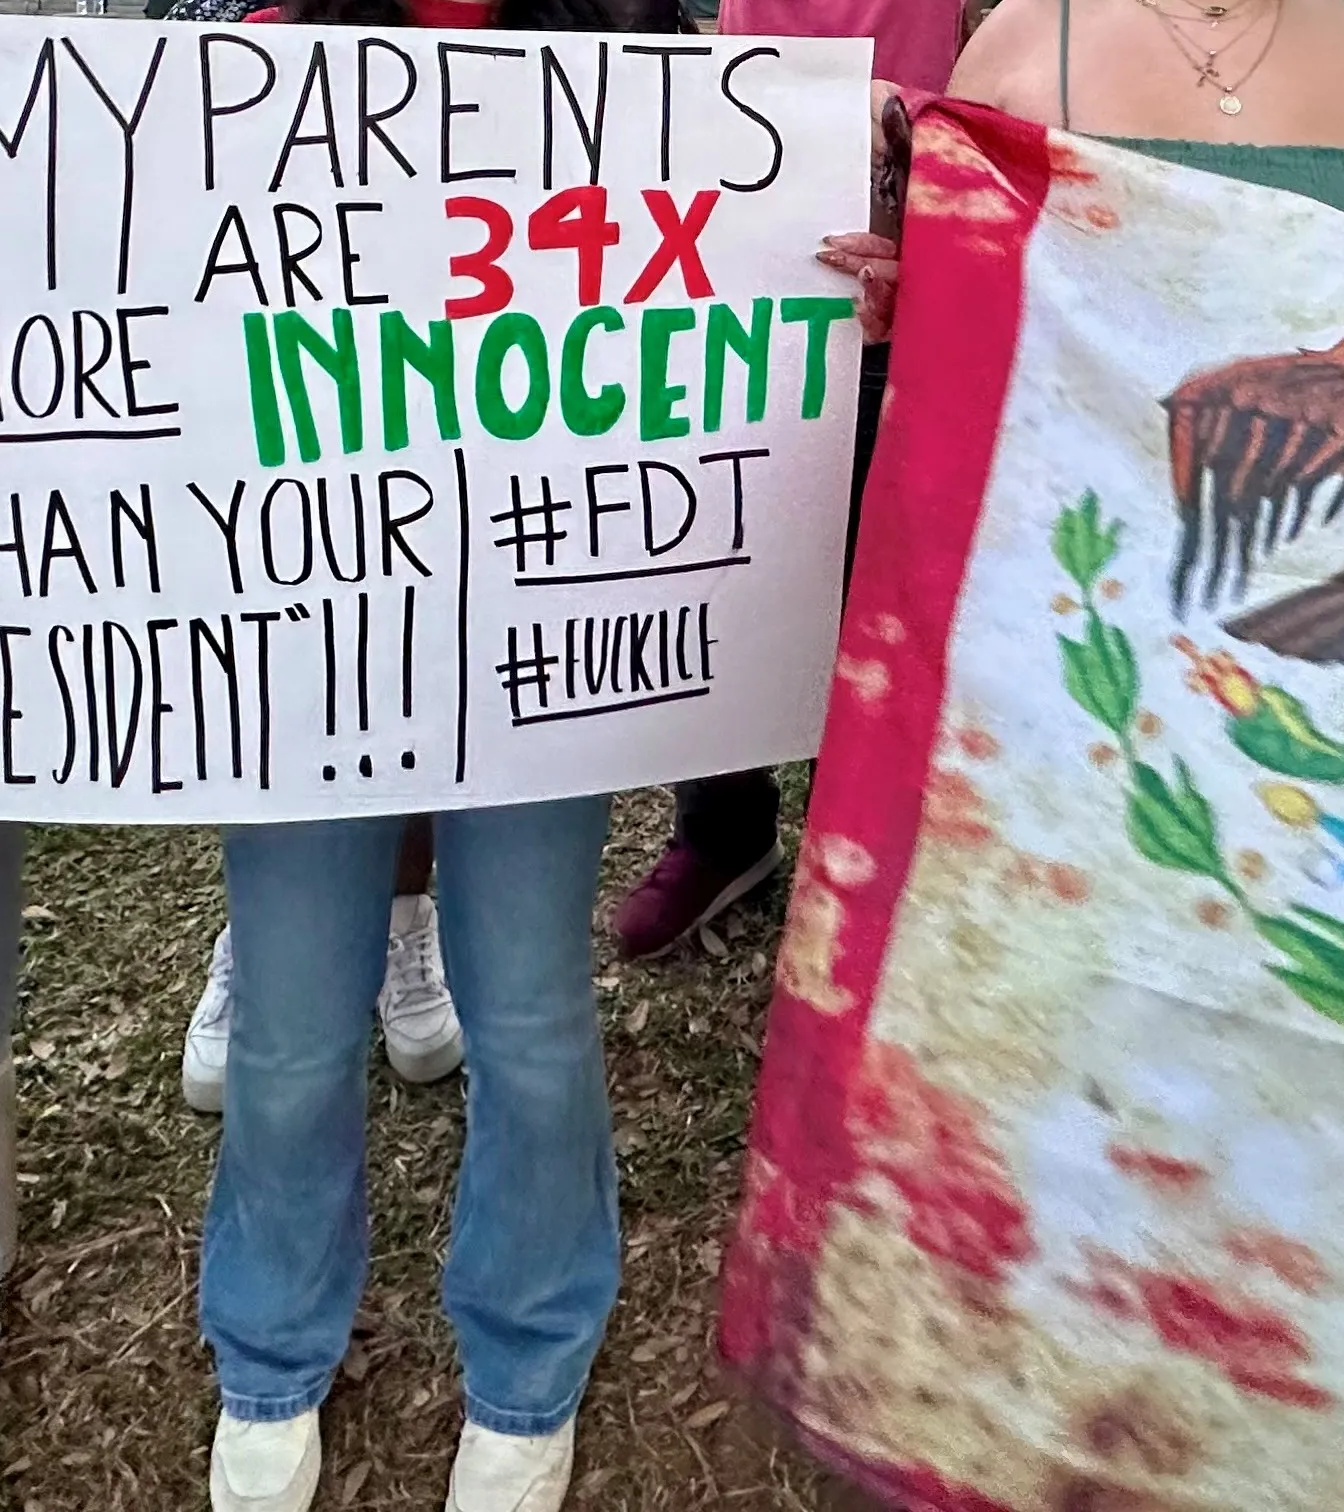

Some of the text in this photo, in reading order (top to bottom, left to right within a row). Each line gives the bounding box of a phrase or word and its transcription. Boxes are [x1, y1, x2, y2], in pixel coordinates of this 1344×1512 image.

[201, 33, 784, 193] PARENTS
[194, 185, 721, 319] ARE 34X
[244, 297, 856, 468] INNOCENT
[186, 469, 434, 595] YOUR
[490, 448, 770, 572] #FDT
[495, 602, 719, 718] #FUCKICE
